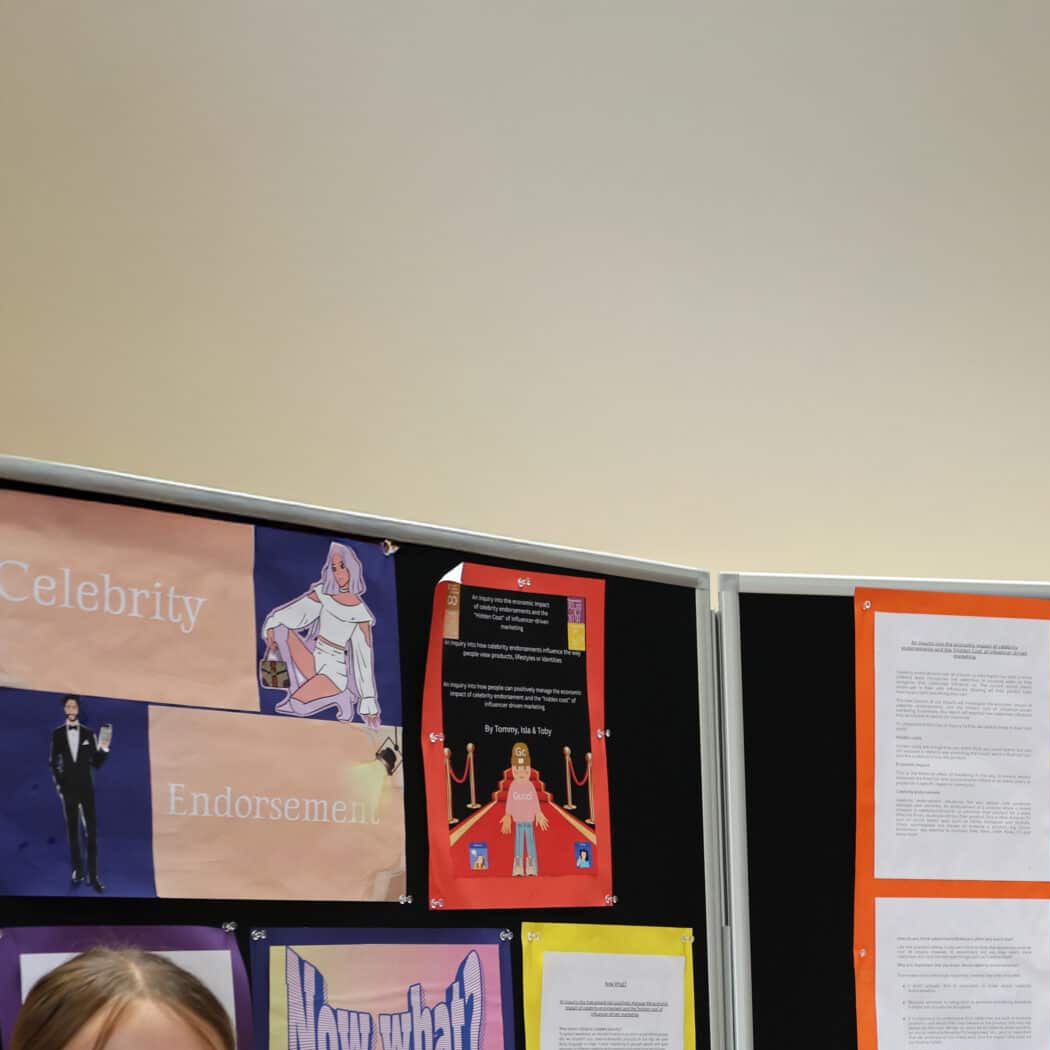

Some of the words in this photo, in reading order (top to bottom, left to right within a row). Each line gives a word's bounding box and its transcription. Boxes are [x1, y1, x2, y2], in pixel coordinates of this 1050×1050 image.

[0, 560, 208, 633] Celebrity
[484, 724, 493, 734] By
[495, 725, 520, 735] Tommy,
[520, 726, 531, 734] Isla
[537, 727, 552, 737] Toby
[167, 783, 381, 825] Endorsement
